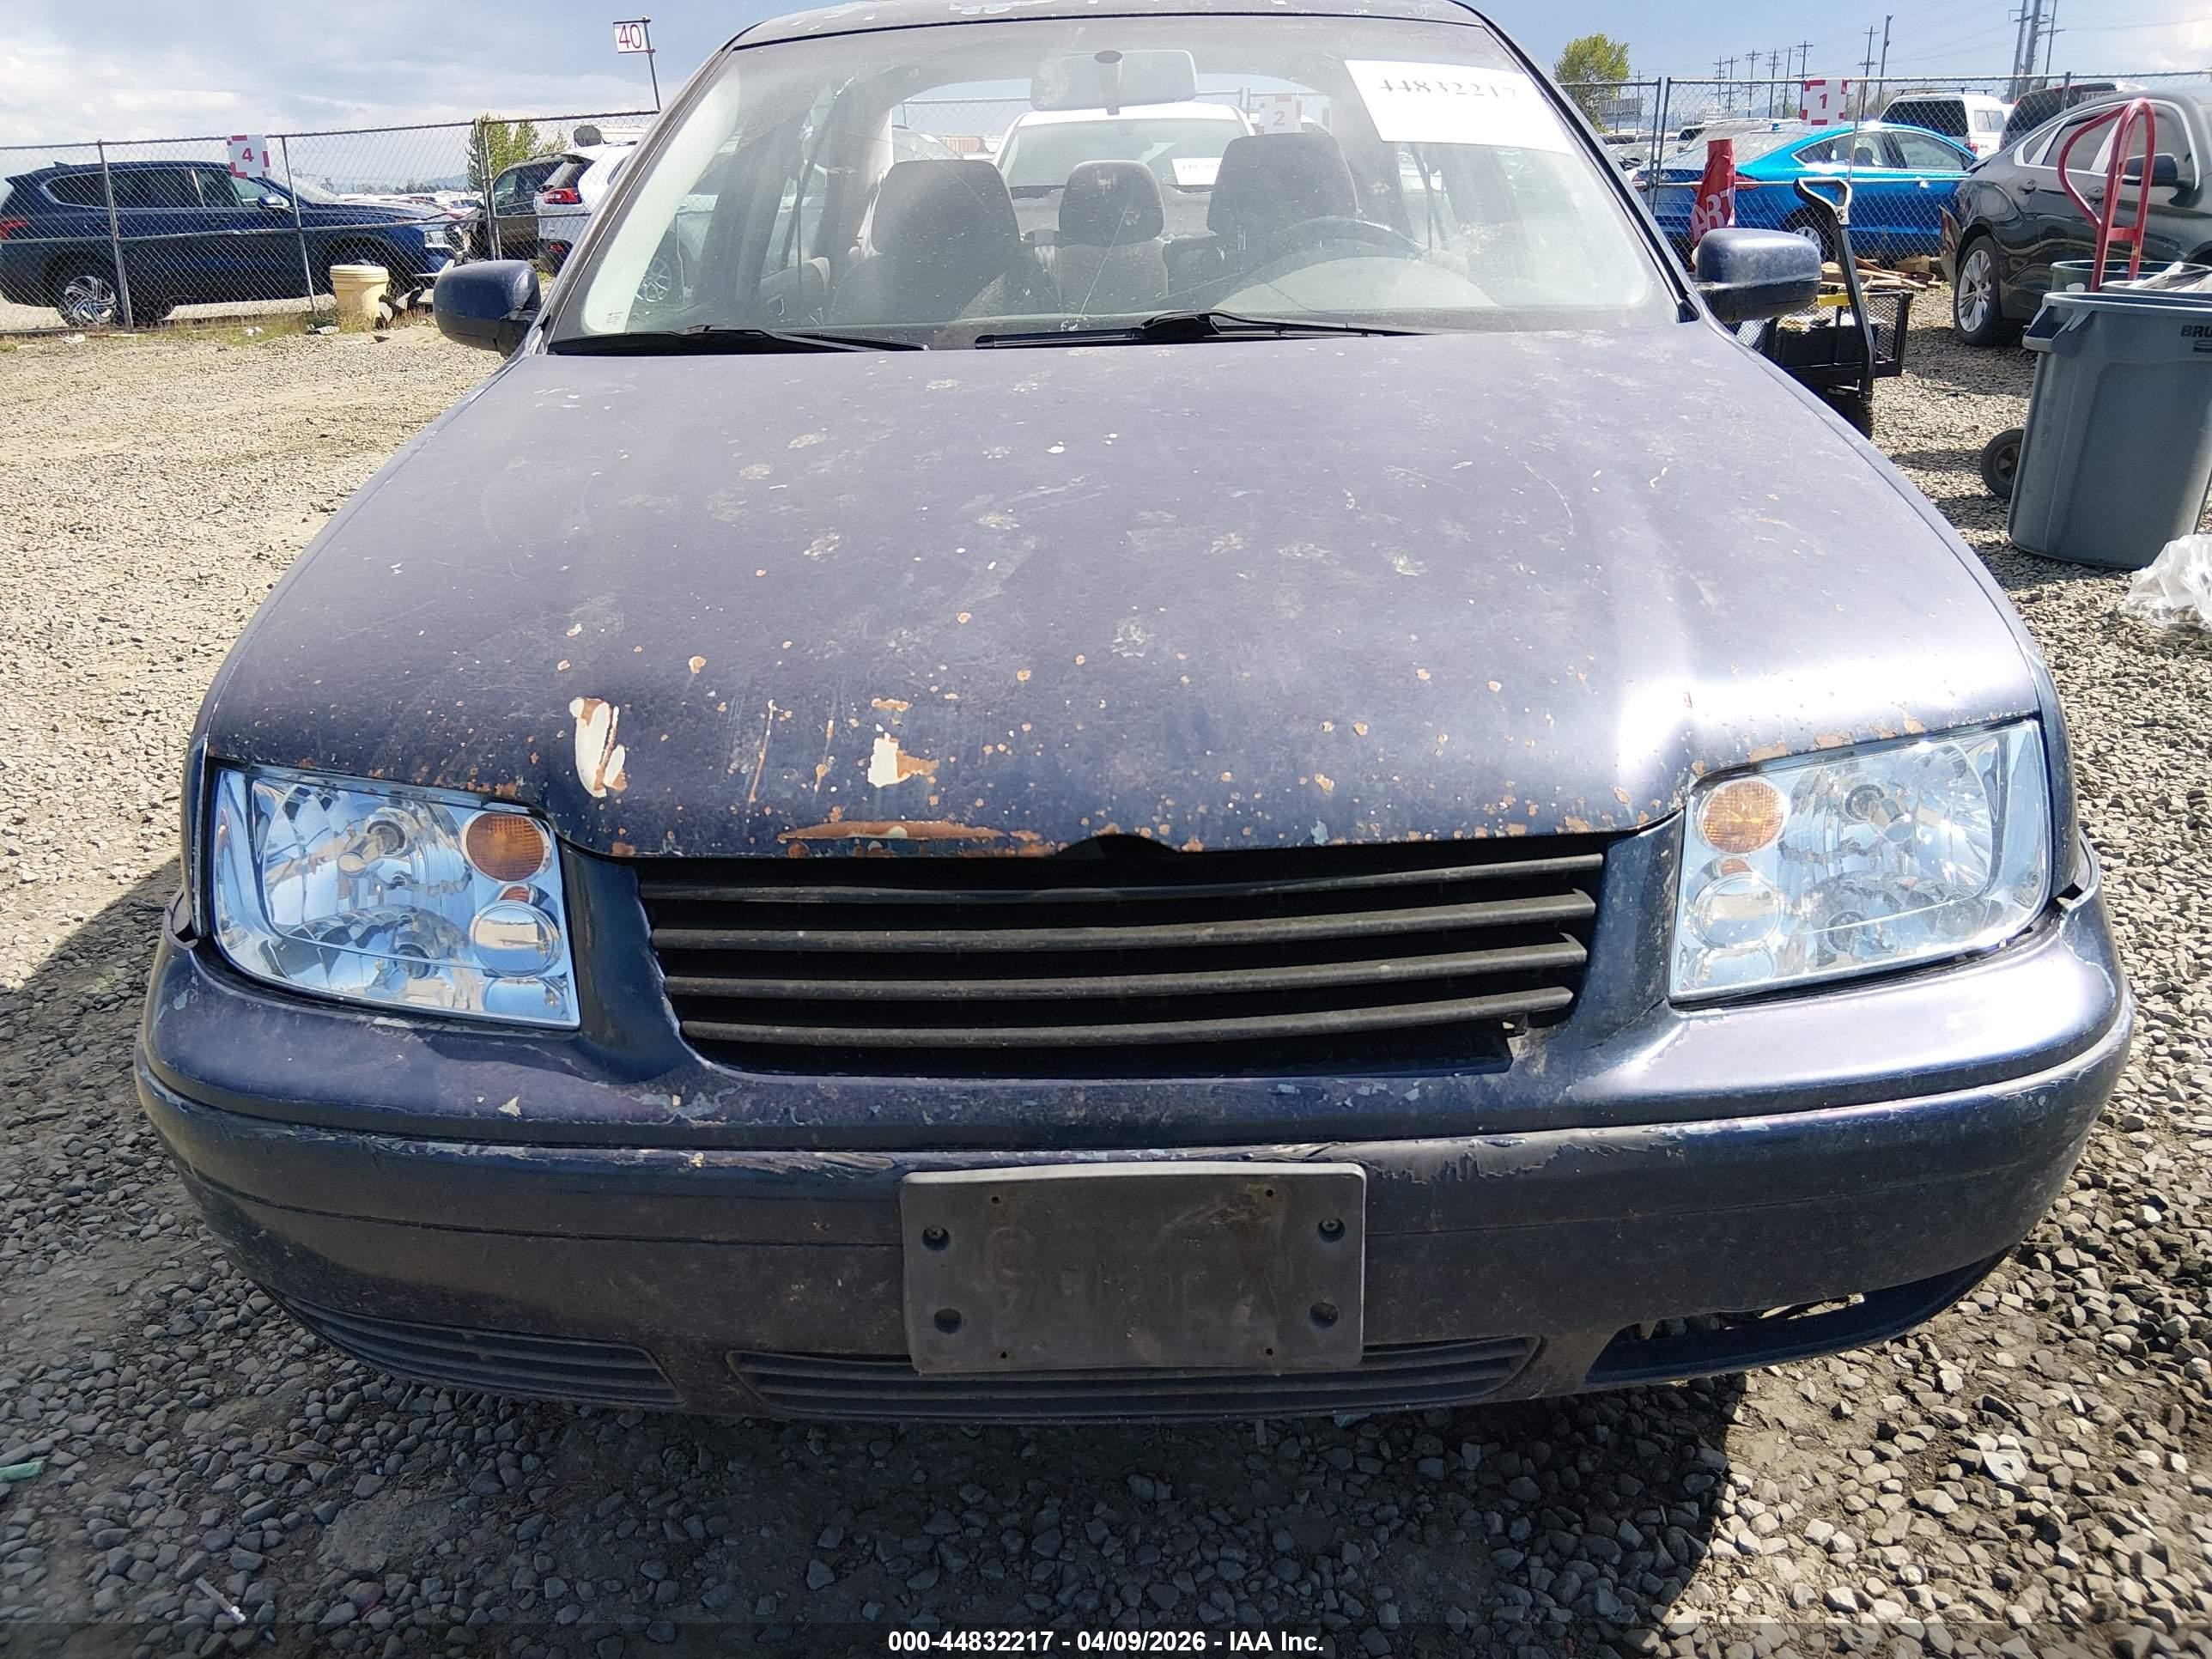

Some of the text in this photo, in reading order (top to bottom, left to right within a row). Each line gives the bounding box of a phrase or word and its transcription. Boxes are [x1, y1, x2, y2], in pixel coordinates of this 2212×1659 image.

[619, 25, 641, 49] 40
[1600, 98, 1642, 112] NATIONAL
[1820, 94, 1827, 109] 1
[1273, 110, 1285, 126] 2
[242, 148, 254, 161] 4
